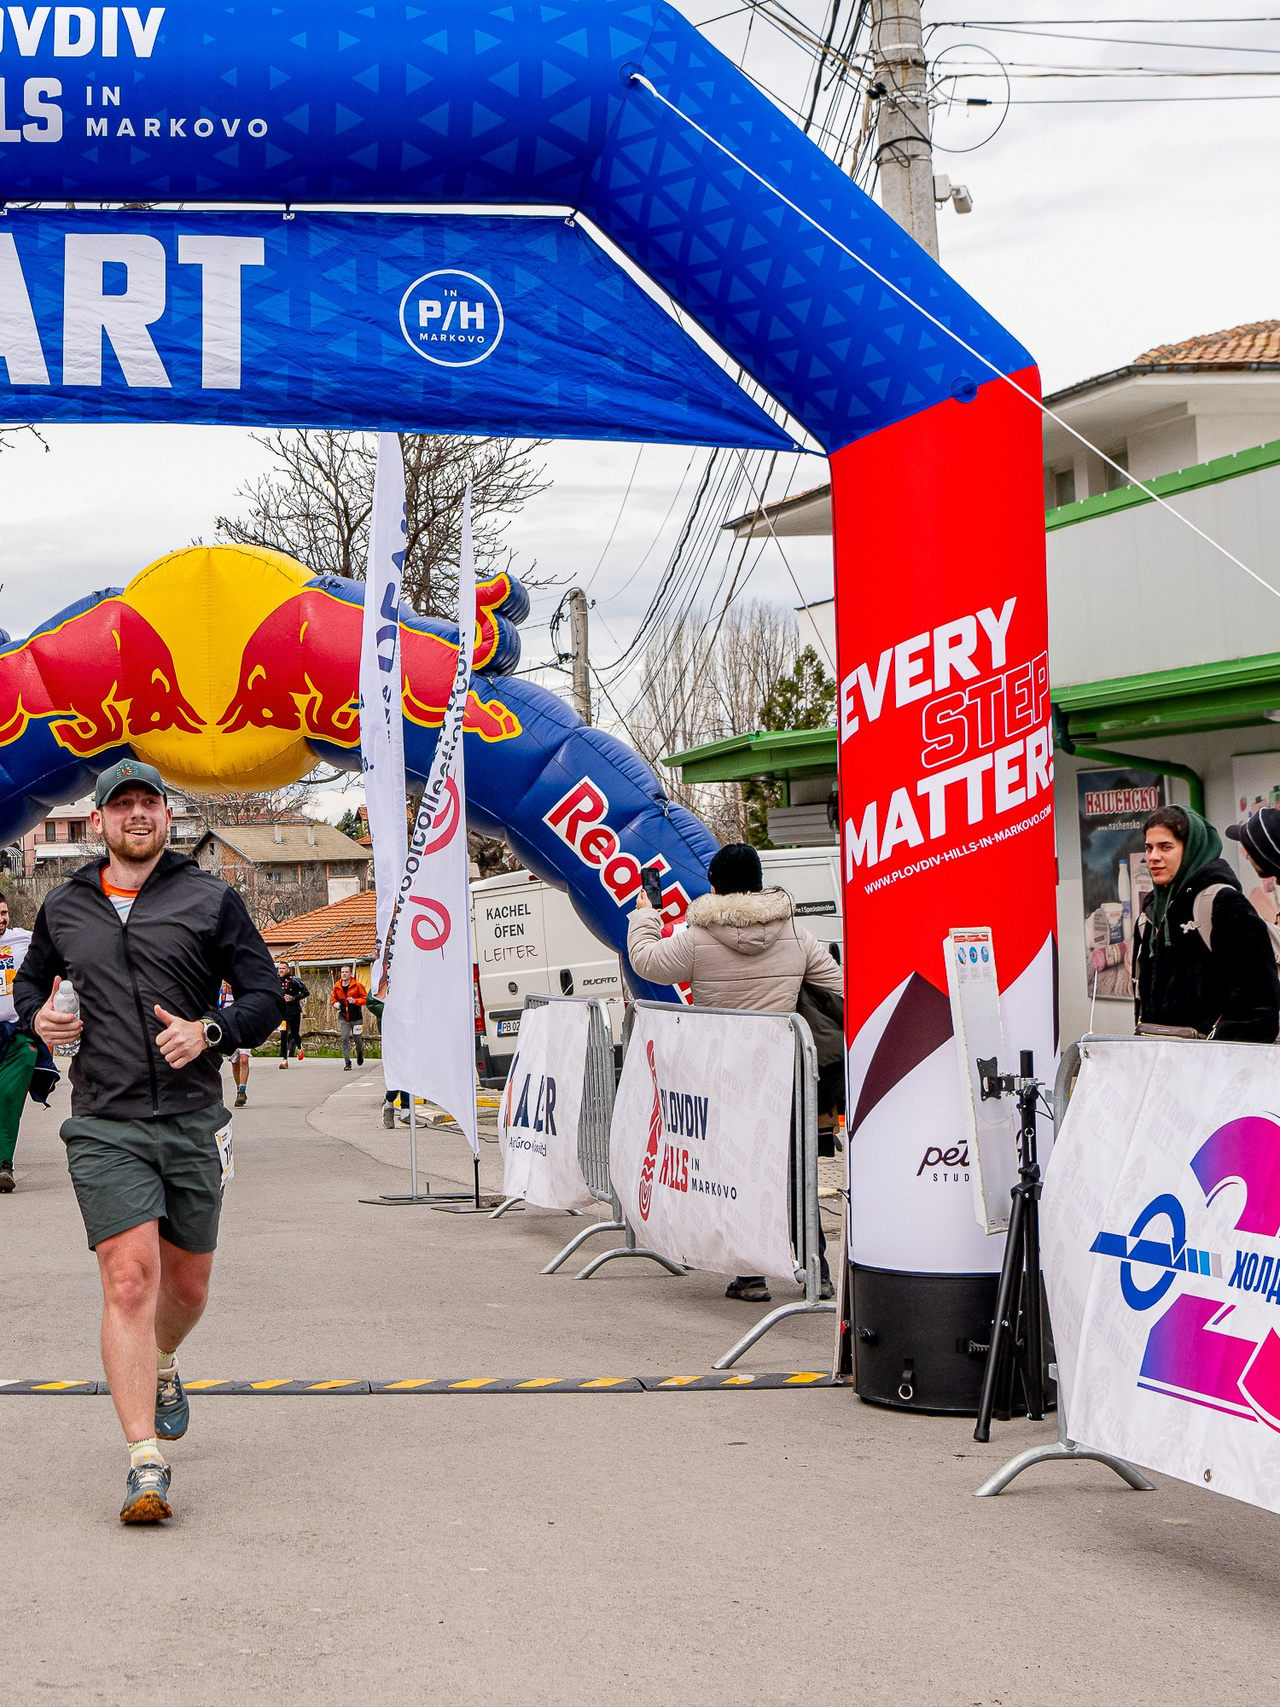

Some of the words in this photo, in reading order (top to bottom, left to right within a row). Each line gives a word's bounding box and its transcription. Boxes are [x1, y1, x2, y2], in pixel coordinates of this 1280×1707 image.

[86, 86, 121, 107] IN
[85, 117, 269, 138] MARKOVO
[444, 289, 458, 297] IN
[418, 299, 485, 332] P/H
[419, 333, 485, 344] MARKOVO
[841, 596, 1017, 745] EVERY
[922, 650, 1049, 769] STEP
[1085, 787, 1158, 815] НАШЕНСКО
[546, 778, 670, 905] Red
[864, 804, 1052, 895] WWW.PLOVDIV-HILLS-IN-MARKOVO.COM
[485, 902, 532, 921] KACHEL
[494, 922, 525, 939] ÖFEN
[483, 944, 539, 963] LEITER
[582, 976, 618, 986] DUCATO
[691, 1157, 700, 1172] IN
[691, 1177, 738, 1201] MARKOVO
